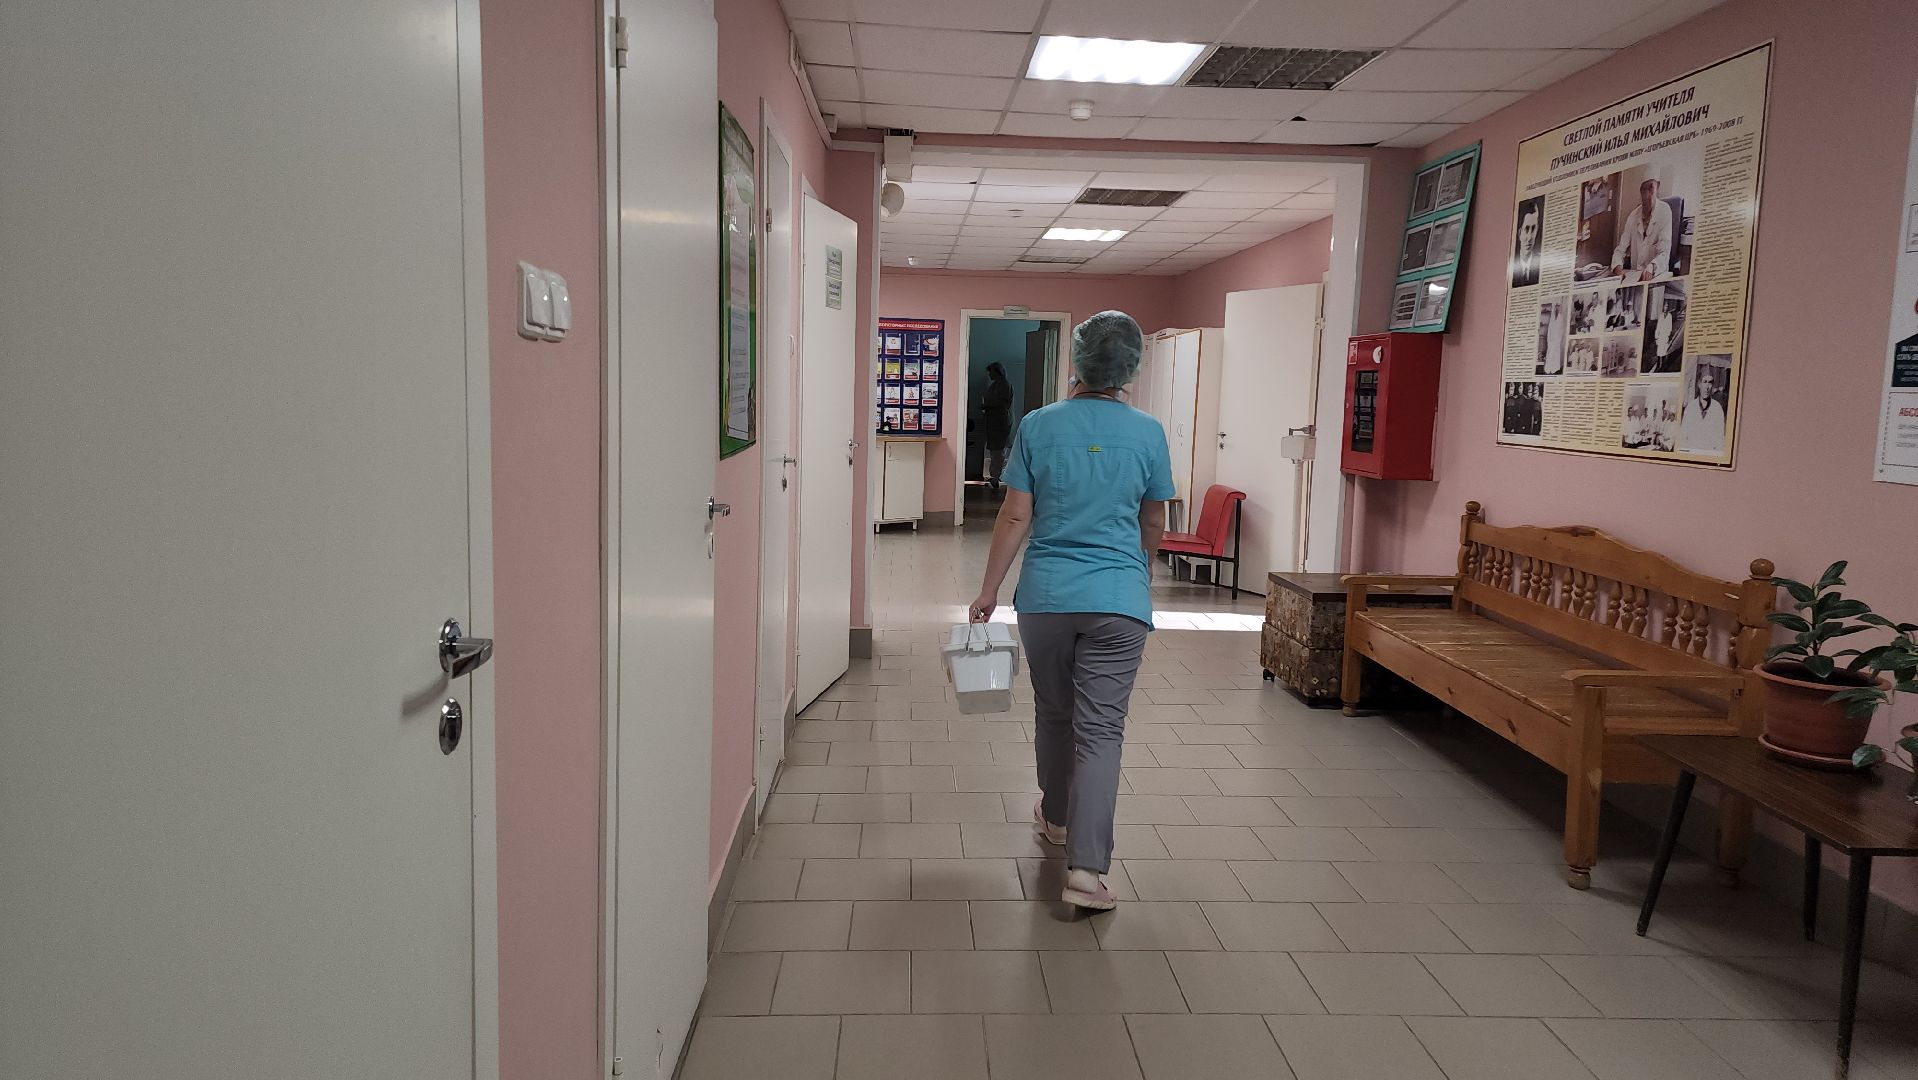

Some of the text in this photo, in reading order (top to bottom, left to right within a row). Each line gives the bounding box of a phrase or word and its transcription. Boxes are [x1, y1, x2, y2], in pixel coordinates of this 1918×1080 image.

[1550, 103, 1711, 171] ПУЧИНСКИЙ ИЛЬЯ МИХАЙЛОВИЧ
[1563, 86, 1696, 147] СВЕТЛОЙ ПАМЯТИ УЧИТЕЛЯ
